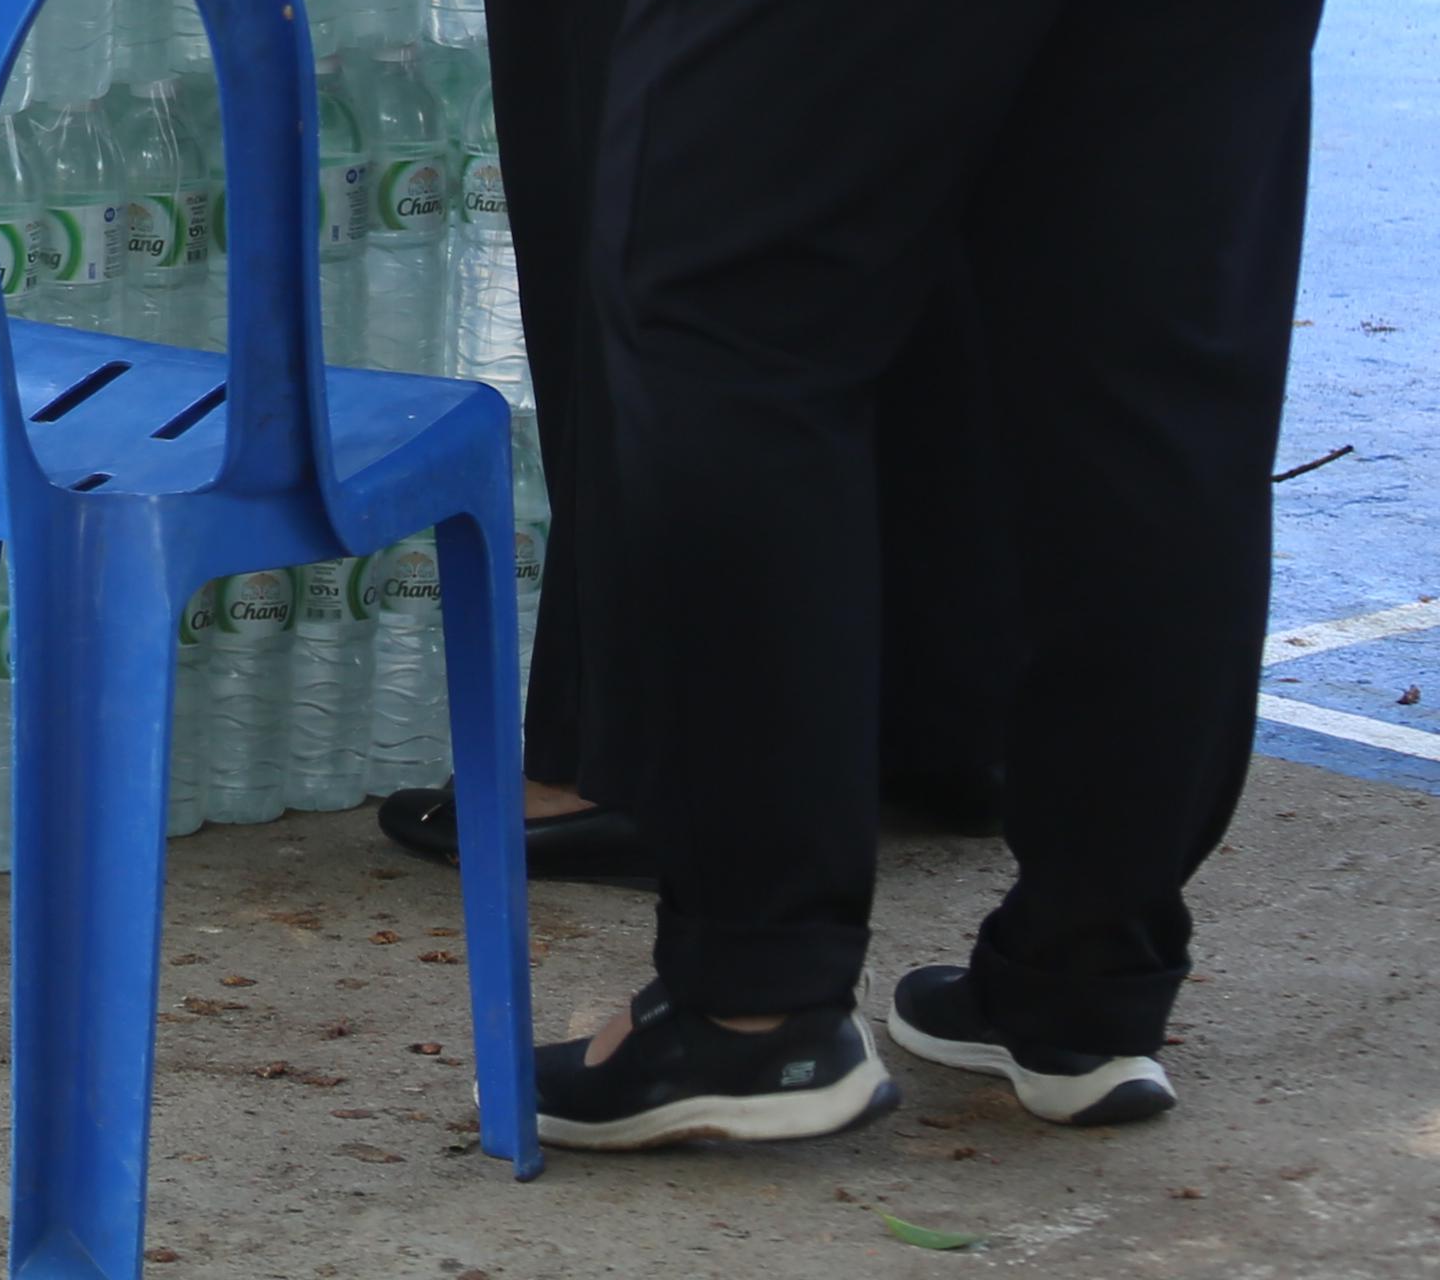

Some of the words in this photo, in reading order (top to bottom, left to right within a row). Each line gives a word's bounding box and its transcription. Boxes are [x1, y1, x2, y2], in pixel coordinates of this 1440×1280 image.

[465, 192, 508, 214] Chan
[128, 236, 165, 256] ang
[384, 578, 442, 602] Chang
[230, 600, 289, 623] Chang
